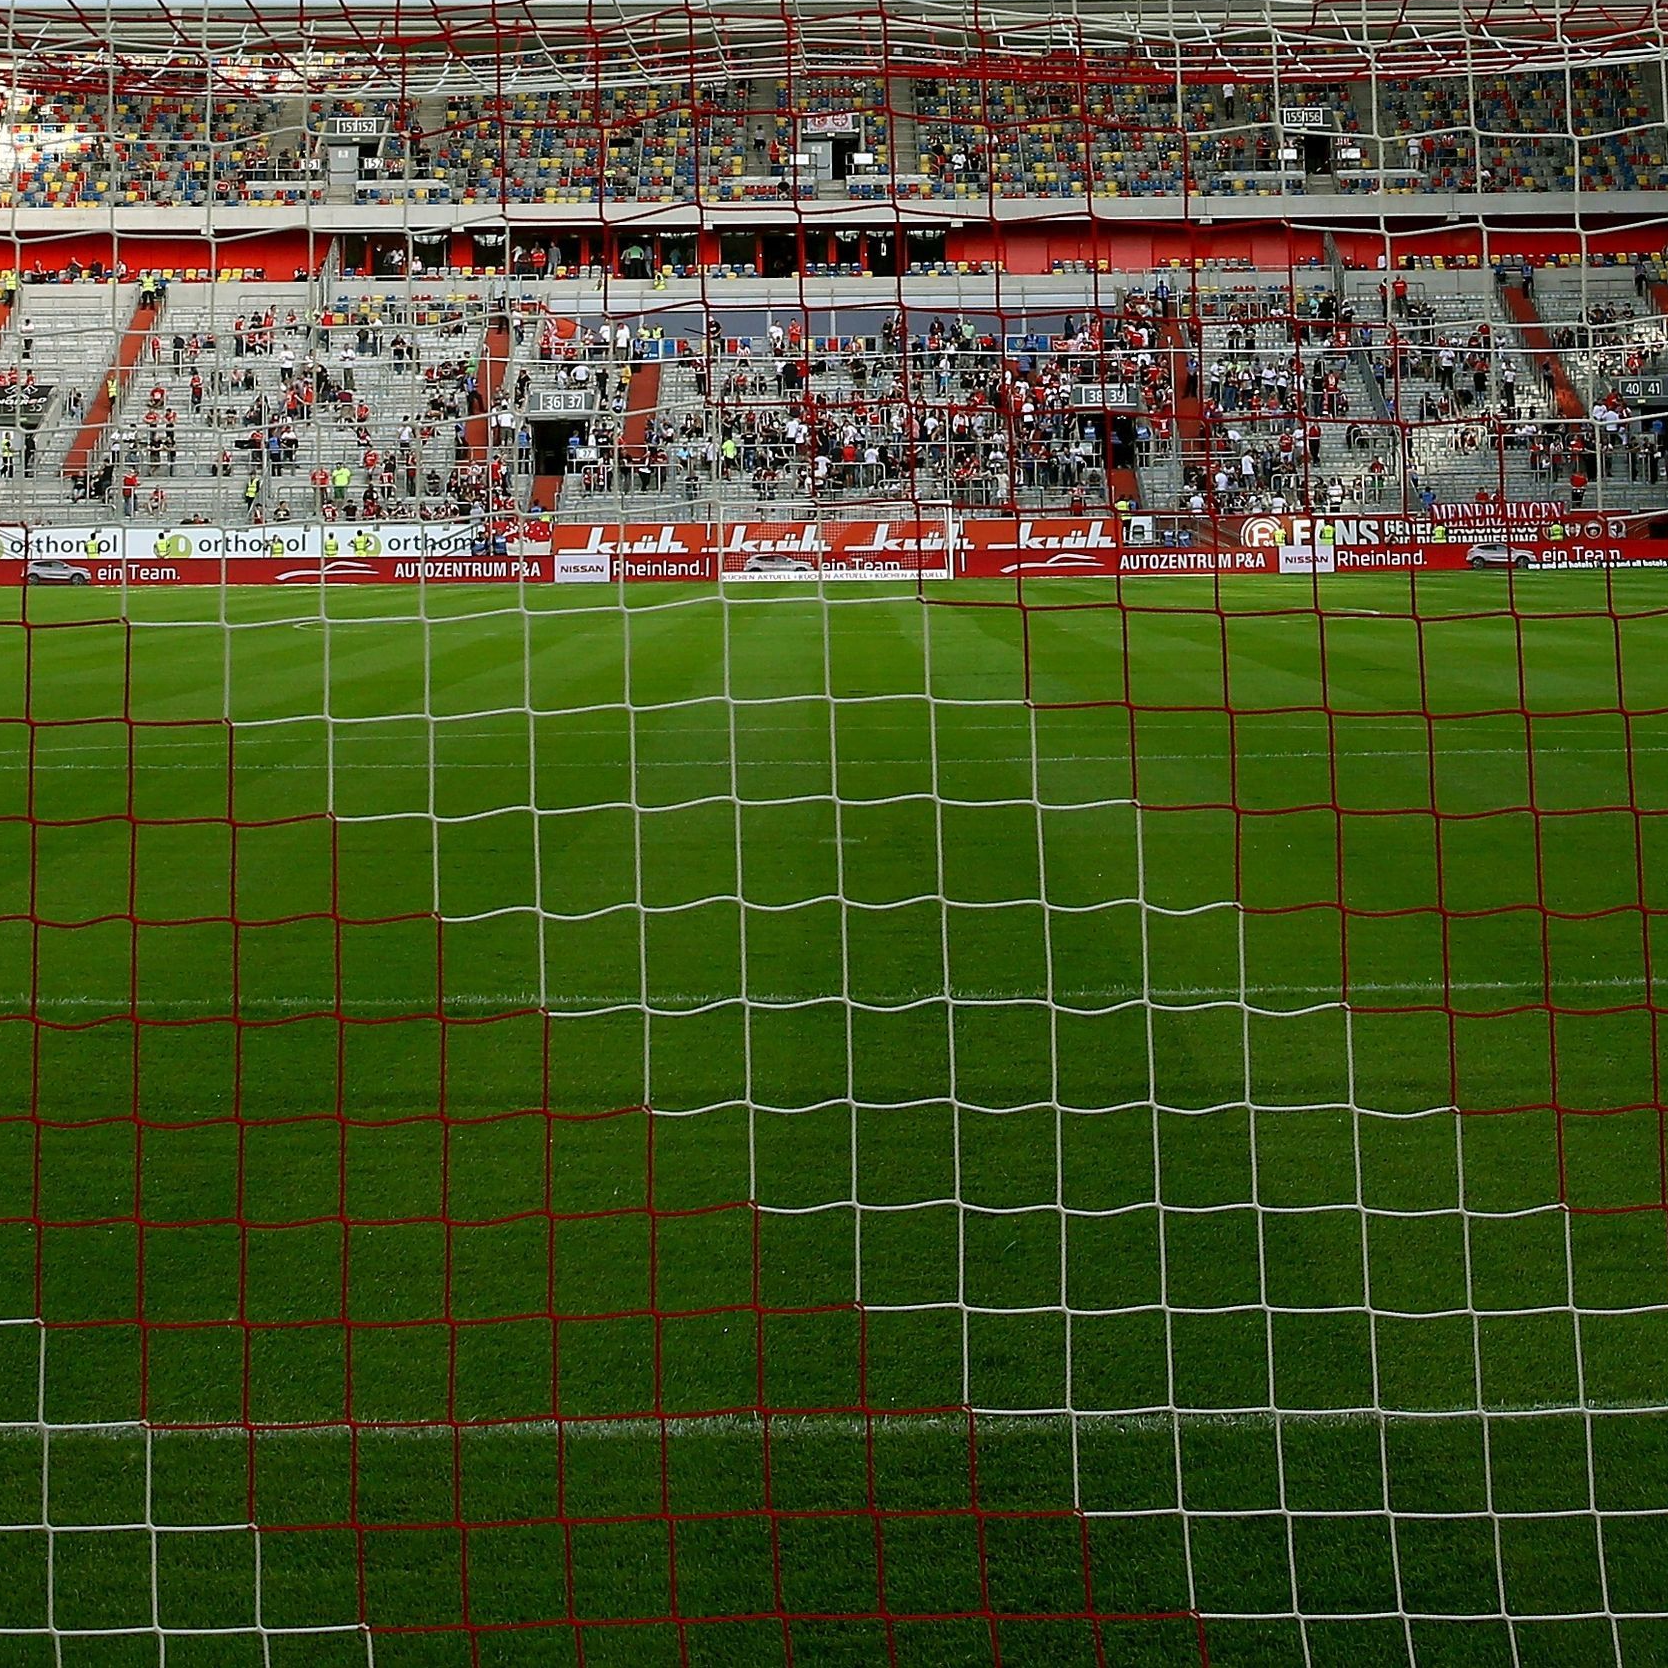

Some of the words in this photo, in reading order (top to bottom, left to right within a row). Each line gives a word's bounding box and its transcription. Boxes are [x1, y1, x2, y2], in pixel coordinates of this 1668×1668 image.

[1286, 112, 1302, 122] 155
[1304, 112, 1320, 122] 156
[358, 121, 374, 132] 152
[1626, 383, 1640, 394] 40
[1648, 382, 1660, 394] 41
[546, 396, 561, 409] 36
[568, 396, 582, 408] 37
[1089, 390, 1103, 402] 38
[1109, 390, 1124, 402] 39
[199, 533, 306, 553] orthool
[387, 533, 474, 551] orthom
[1285, 555, 1329, 564] NISSAN
[1337, 549, 1428, 567] Rheinland.
[1542, 546, 1567, 562] ein
[822, 558, 847, 571] ein
[1119, 552, 1232, 571] AUTOZENTRUM
[1235, 551, 1266, 568] P&A
[97, 564, 123, 581] ein
[128, 564, 181, 581] Team.
[394, 562, 511, 578] AUTOZENTRUM
[560, 564, 604, 573] NISSAN
[613, 559, 705, 577] Rheinland.
[798, 572, 831, 581] KÜCHN
[908, 570, 944, 579] ATUELL
